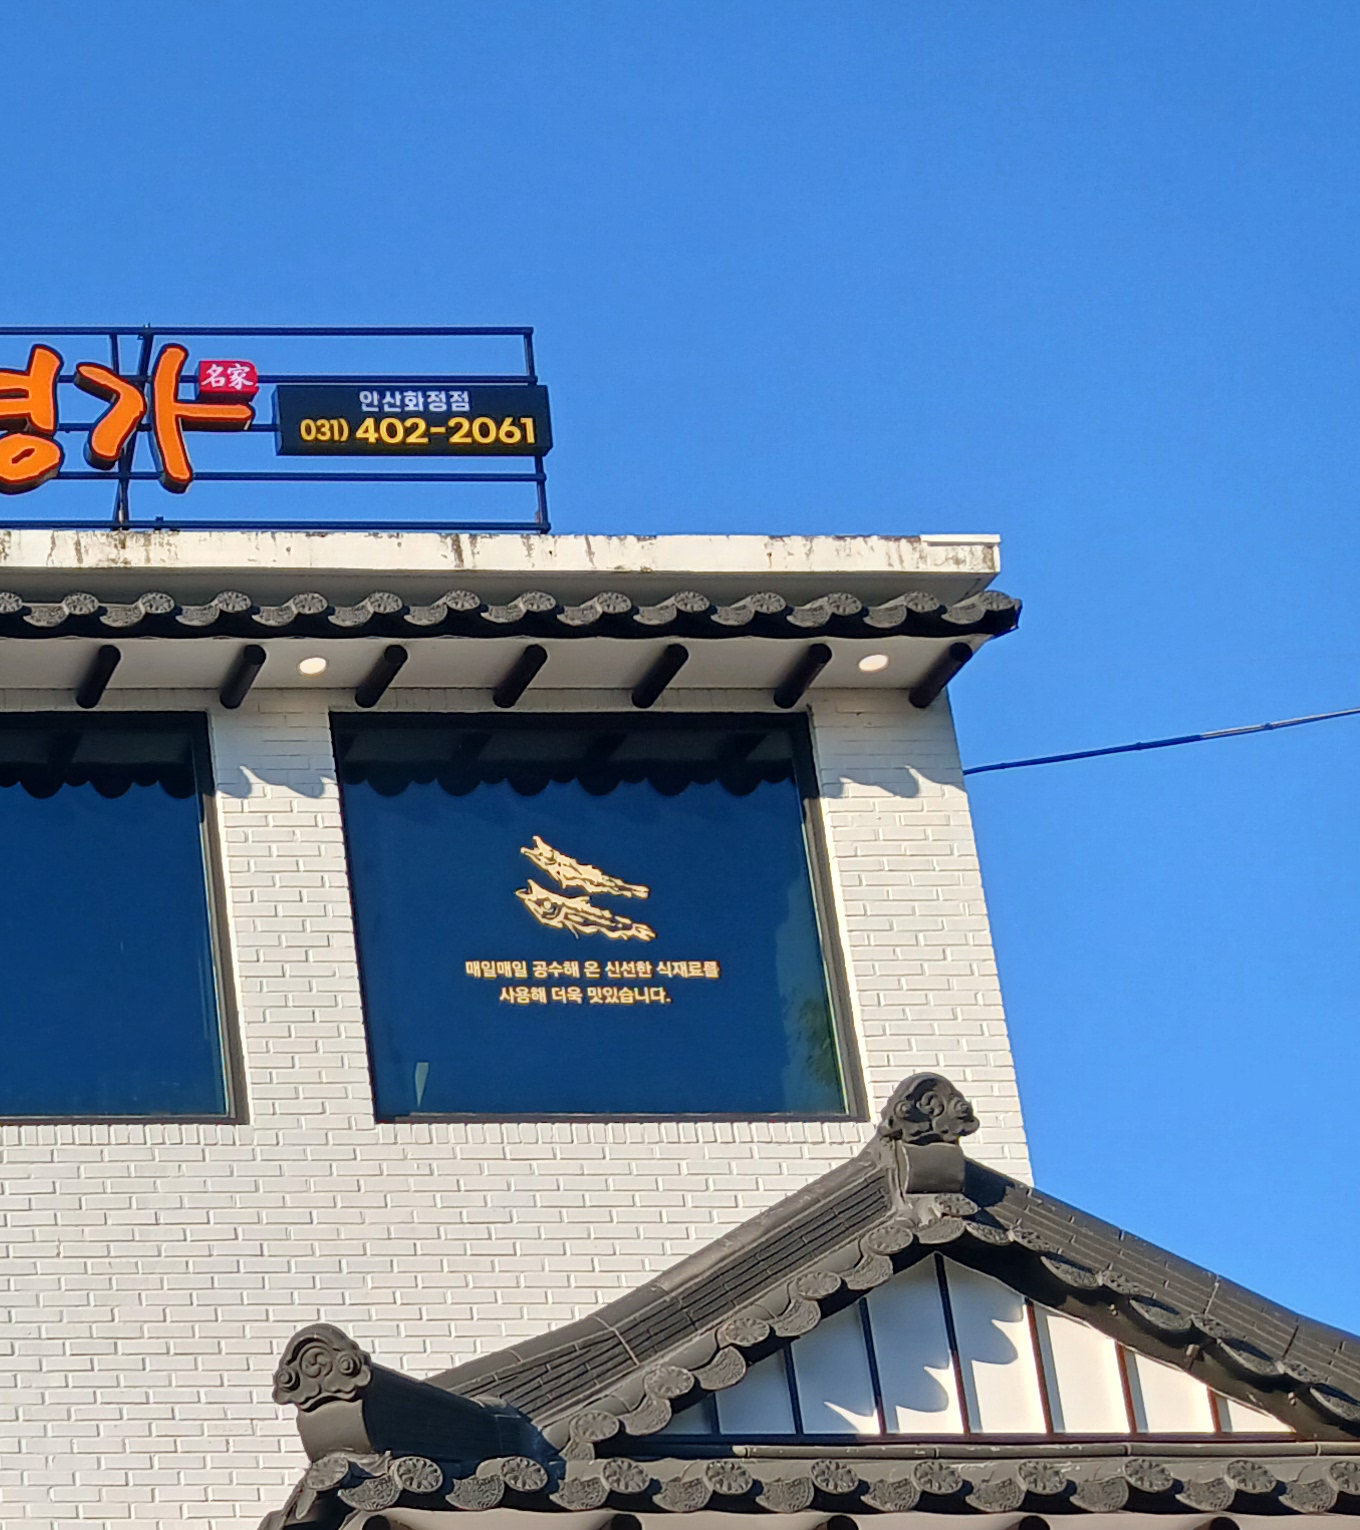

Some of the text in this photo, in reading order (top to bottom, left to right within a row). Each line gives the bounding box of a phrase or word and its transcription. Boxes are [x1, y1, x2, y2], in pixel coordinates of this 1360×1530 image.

[200, 363, 258, 391] 名家
[359, 390, 470, 413] 안산화정점
[299, 416, 536, 445] 031) 402-2061
[465, 960, 528, 978] 매일매일
[532, 960, 580, 978] 공수해
[583, 961, 601, 978] 온
[605, 960, 653, 979] 신선한
[499, 986, 547, 1004] 사용해
[551, 986, 583, 1004] 더욱
